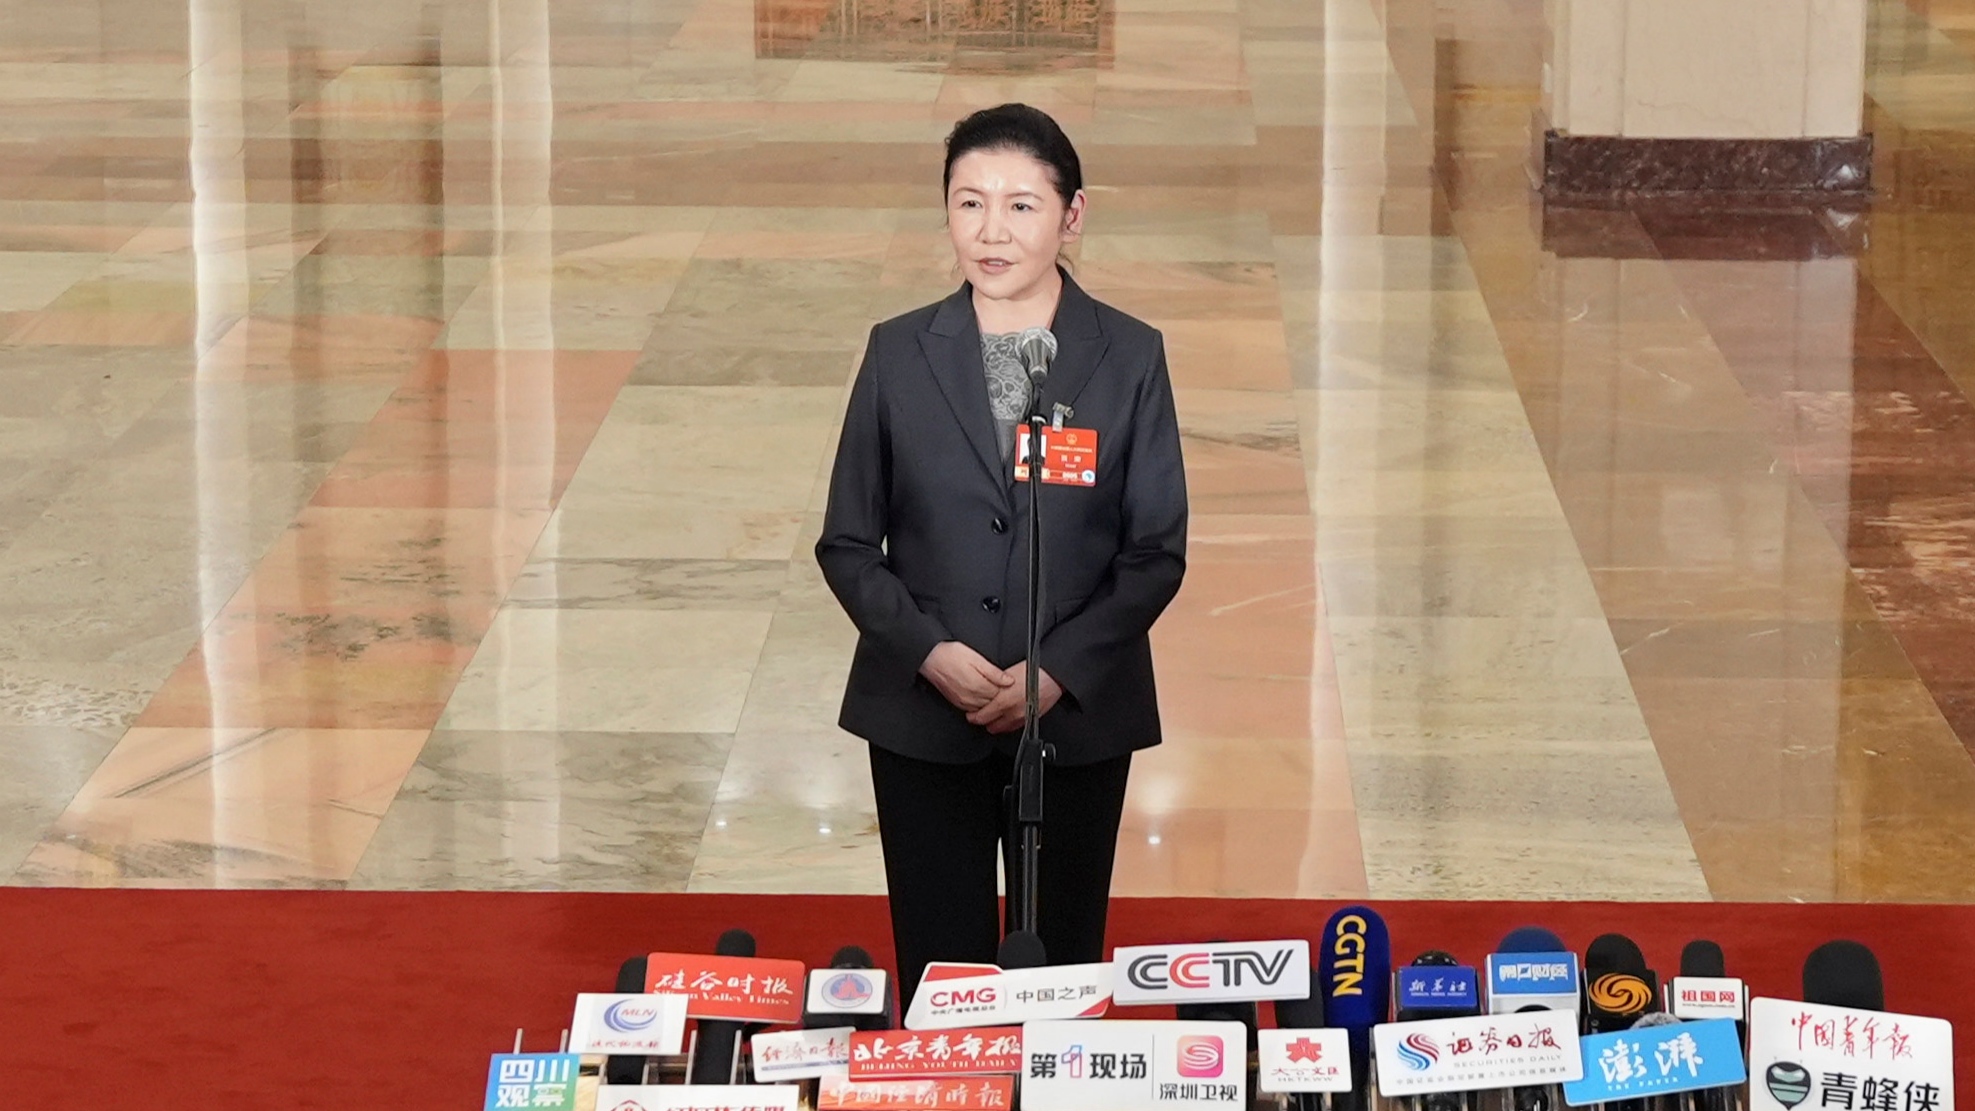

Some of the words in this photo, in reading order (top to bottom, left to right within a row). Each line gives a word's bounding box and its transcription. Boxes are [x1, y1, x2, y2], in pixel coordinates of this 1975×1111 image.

[1332, 915, 1367, 997] CGTN
[1128, 948, 1295, 990] CCTV
[655, 968, 794, 995] 硅谷时报
[702, 992, 742, 1003] Valley
[930, 987, 997, 1007] CMG
[1016, 985, 1097, 1004] 中国之声
[1682, 990, 1735, 1003] 祖国网
[621, 1008, 655, 1017] MLN
[1446, 1023, 1562, 1056] 证券日报
[1454, 1057, 1525, 1068] SECURITIES
[1530, 1054, 1563, 1063] DAILY
[1598, 1032, 1704, 1083] 澎湃
[499, 1059, 570, 1083] 四川
[495, 1083, 567, 1108] 观察
[1159, 1083, 1239, 1102] 深圳卫视
[1820, 1072, 1940, 1111] 青蜂侠
